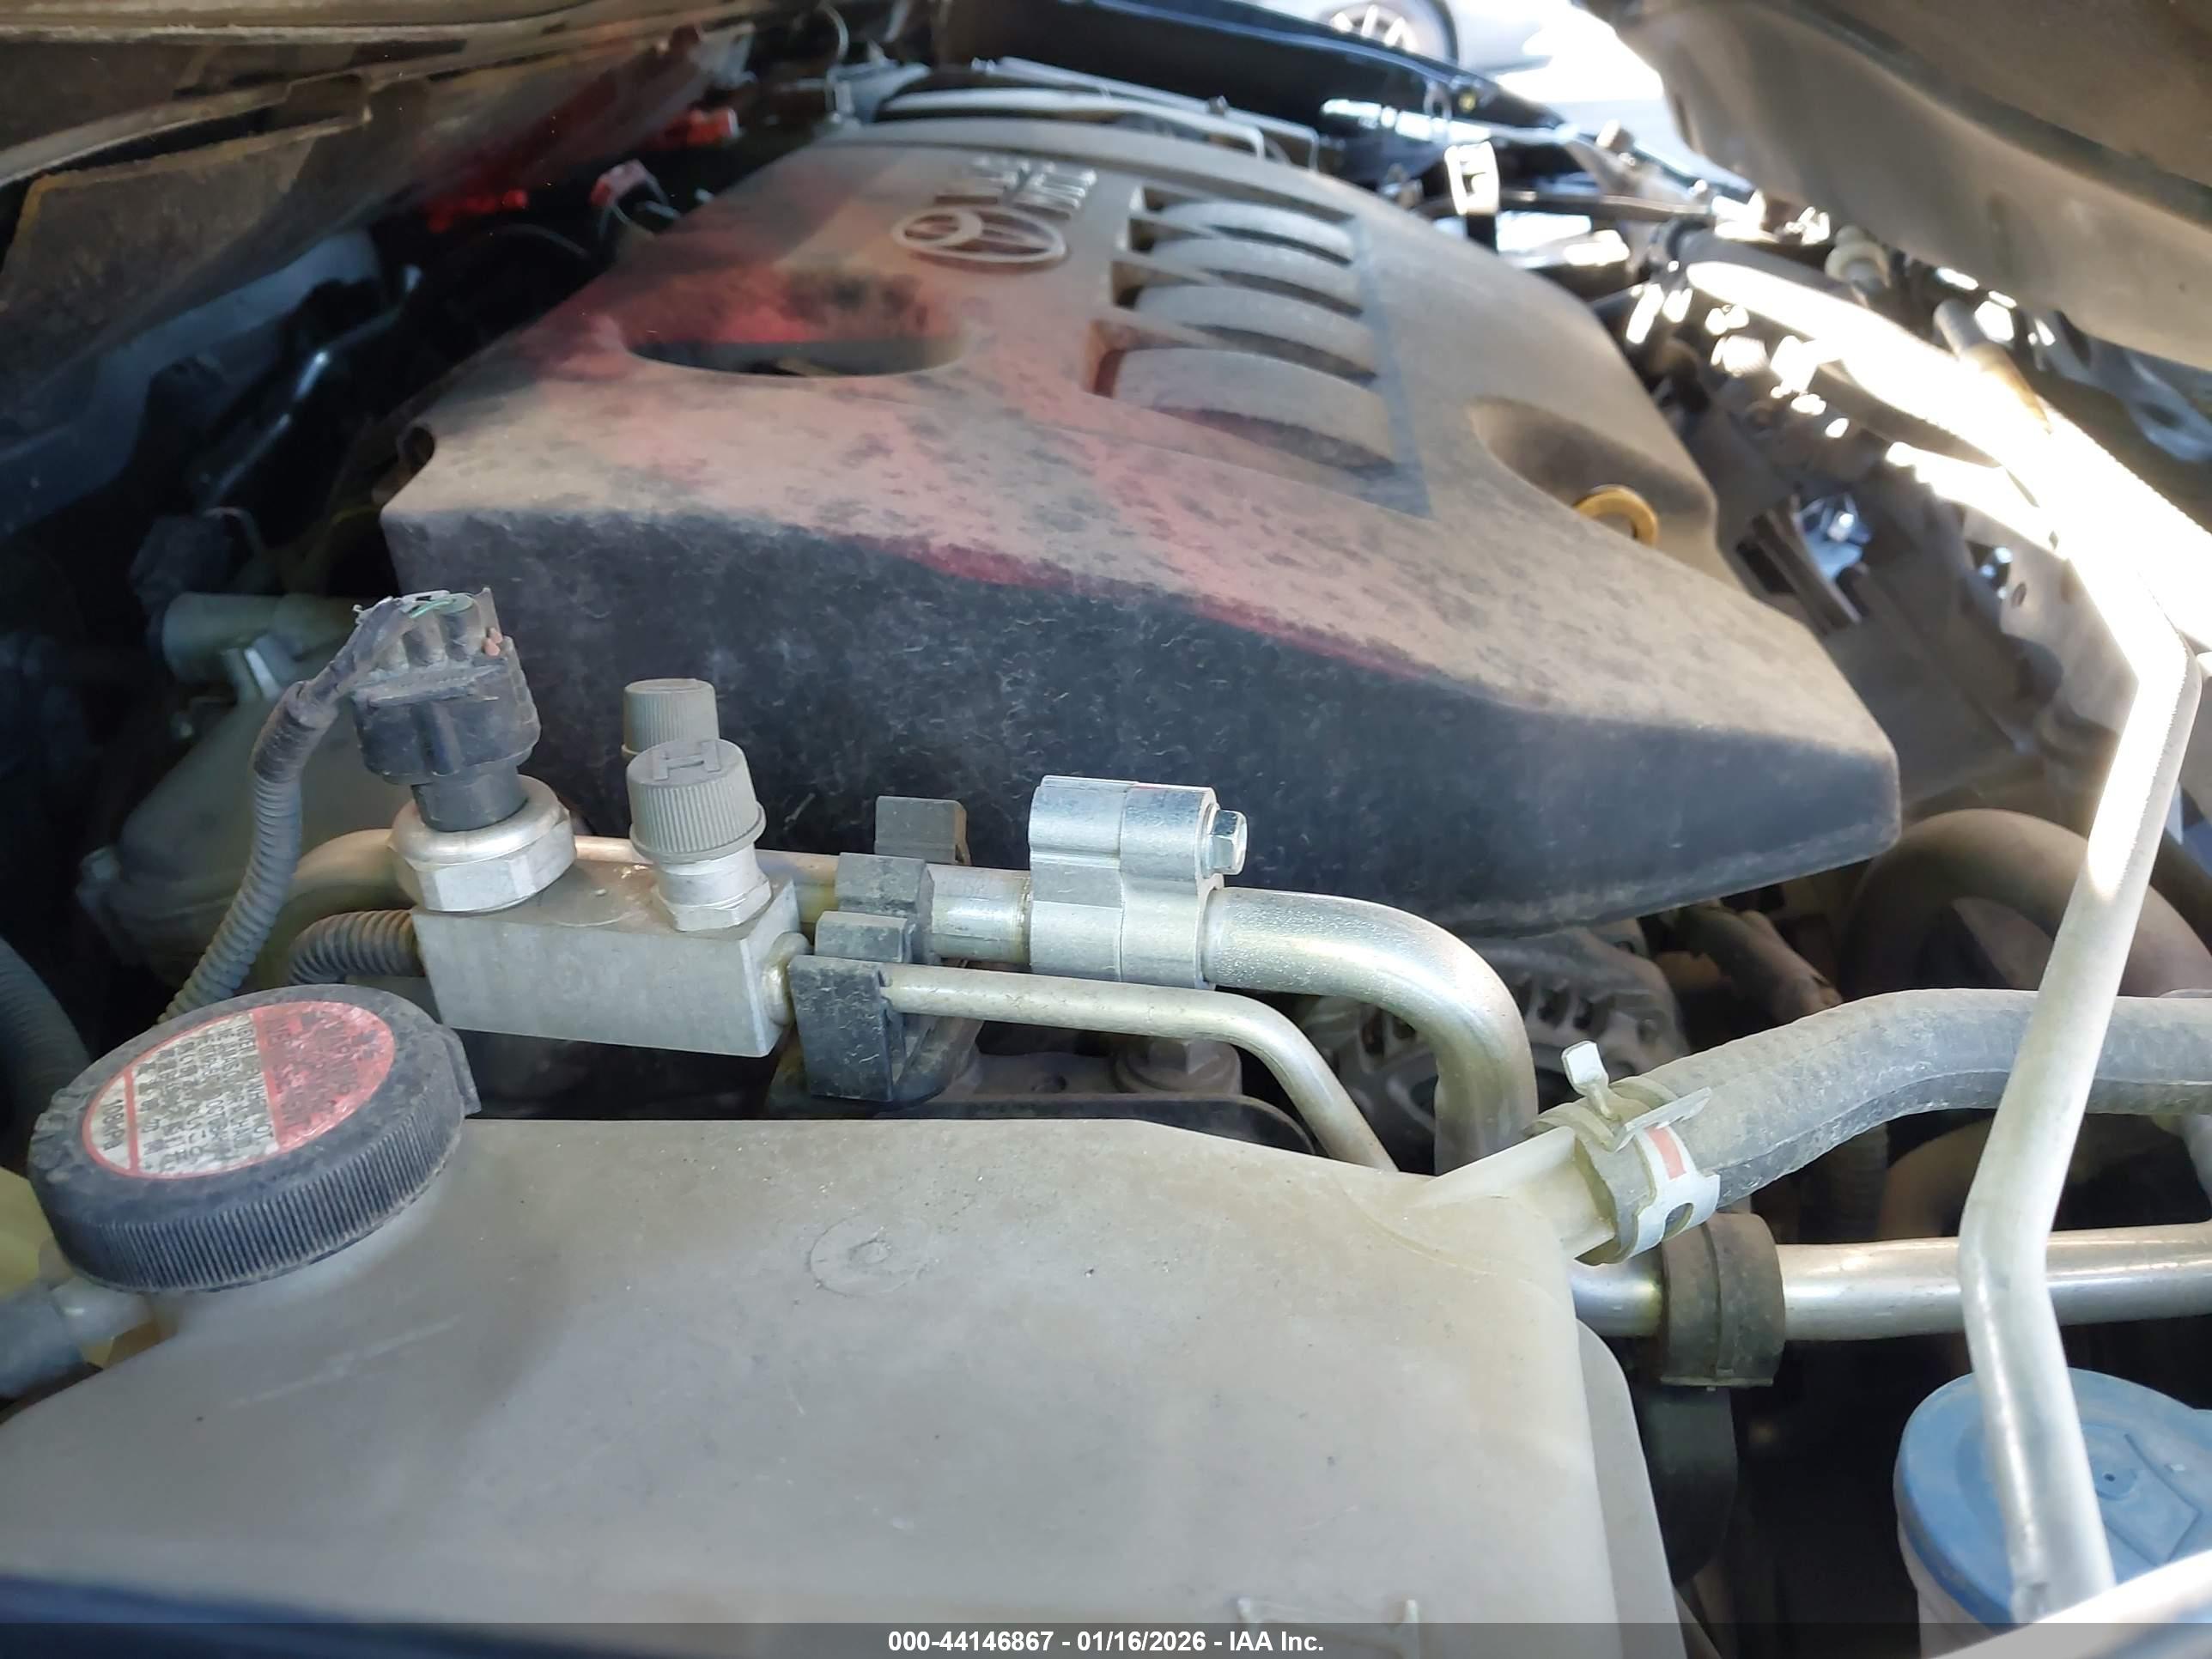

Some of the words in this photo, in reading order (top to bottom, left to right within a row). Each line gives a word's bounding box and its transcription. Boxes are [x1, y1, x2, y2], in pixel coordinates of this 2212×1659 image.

[235, 1023, 257, 1054] NEVER
[241, 1054, 262, 1080] EN
[246, 1080, 269, 1115] WH
[103, 1099, 125, 1151] 108kPa
